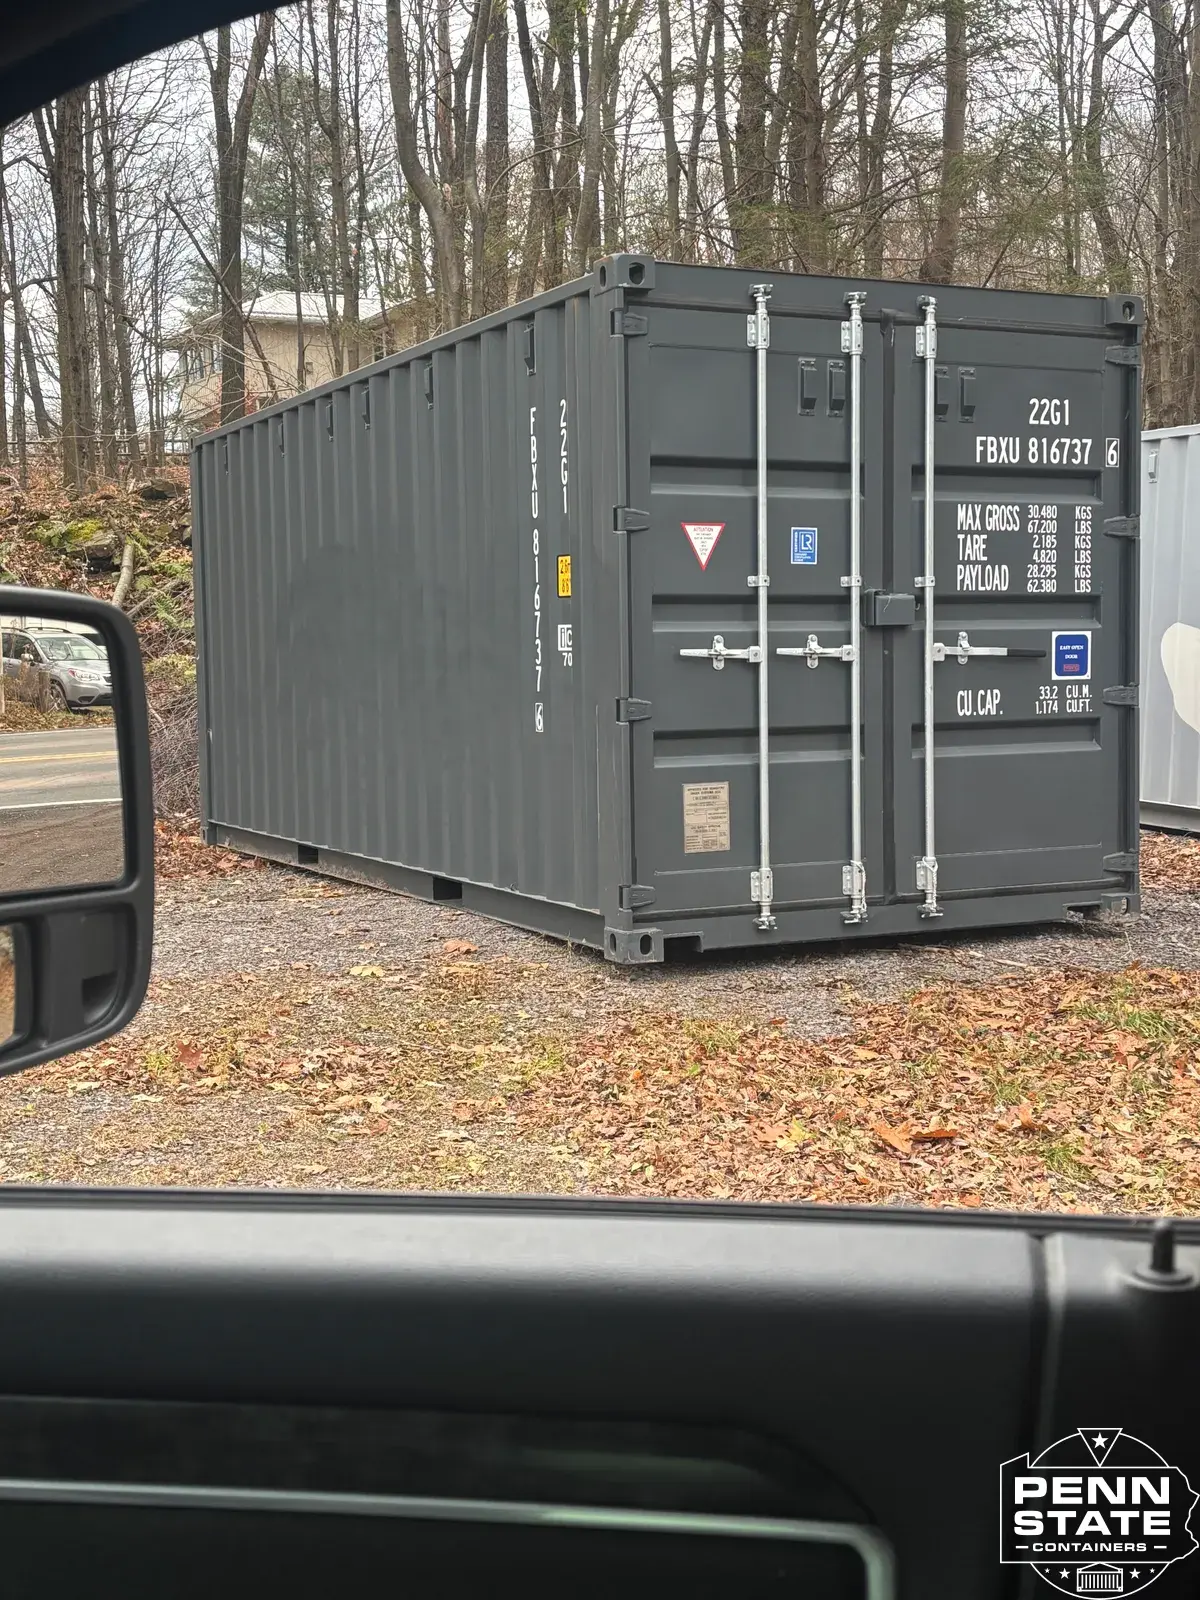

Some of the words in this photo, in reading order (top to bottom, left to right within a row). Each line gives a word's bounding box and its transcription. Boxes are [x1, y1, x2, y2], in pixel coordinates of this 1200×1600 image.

[1029, 398, 1069, 425] 22G1
[530, 407, 538, 519] FBXU
[560, 399, 568, 514] 22G1
[976, 436, 1020, 463] FBXU
[1028, 437, 1092, 465] 816737
[1106, 439, 1118, 466] 6
[957, 504, 982, 531] MAX
[985, 504, 1020, 531] GROSS
[1075, 506, 1092, 520] KGS
[1075, 521, 1092, 534] LBS
[801, 534, 812, 550] LR
[957, 534, 988, 561] TARE
[1075, 535, 1092, 549] KGS
[1075, 550, 1091, 563] LBS
[957, 565, 1009, 591] PAYLOAD
[1075, 565, 1092, 578] KGS
[1075, 579, 1092, 593] LBS
[533, 529, 541, 692] 816737
[562, 652, 573, 666] 70
[1039, 686, 1058, 700] 33.2
[535, 704, 543, 731] 6
